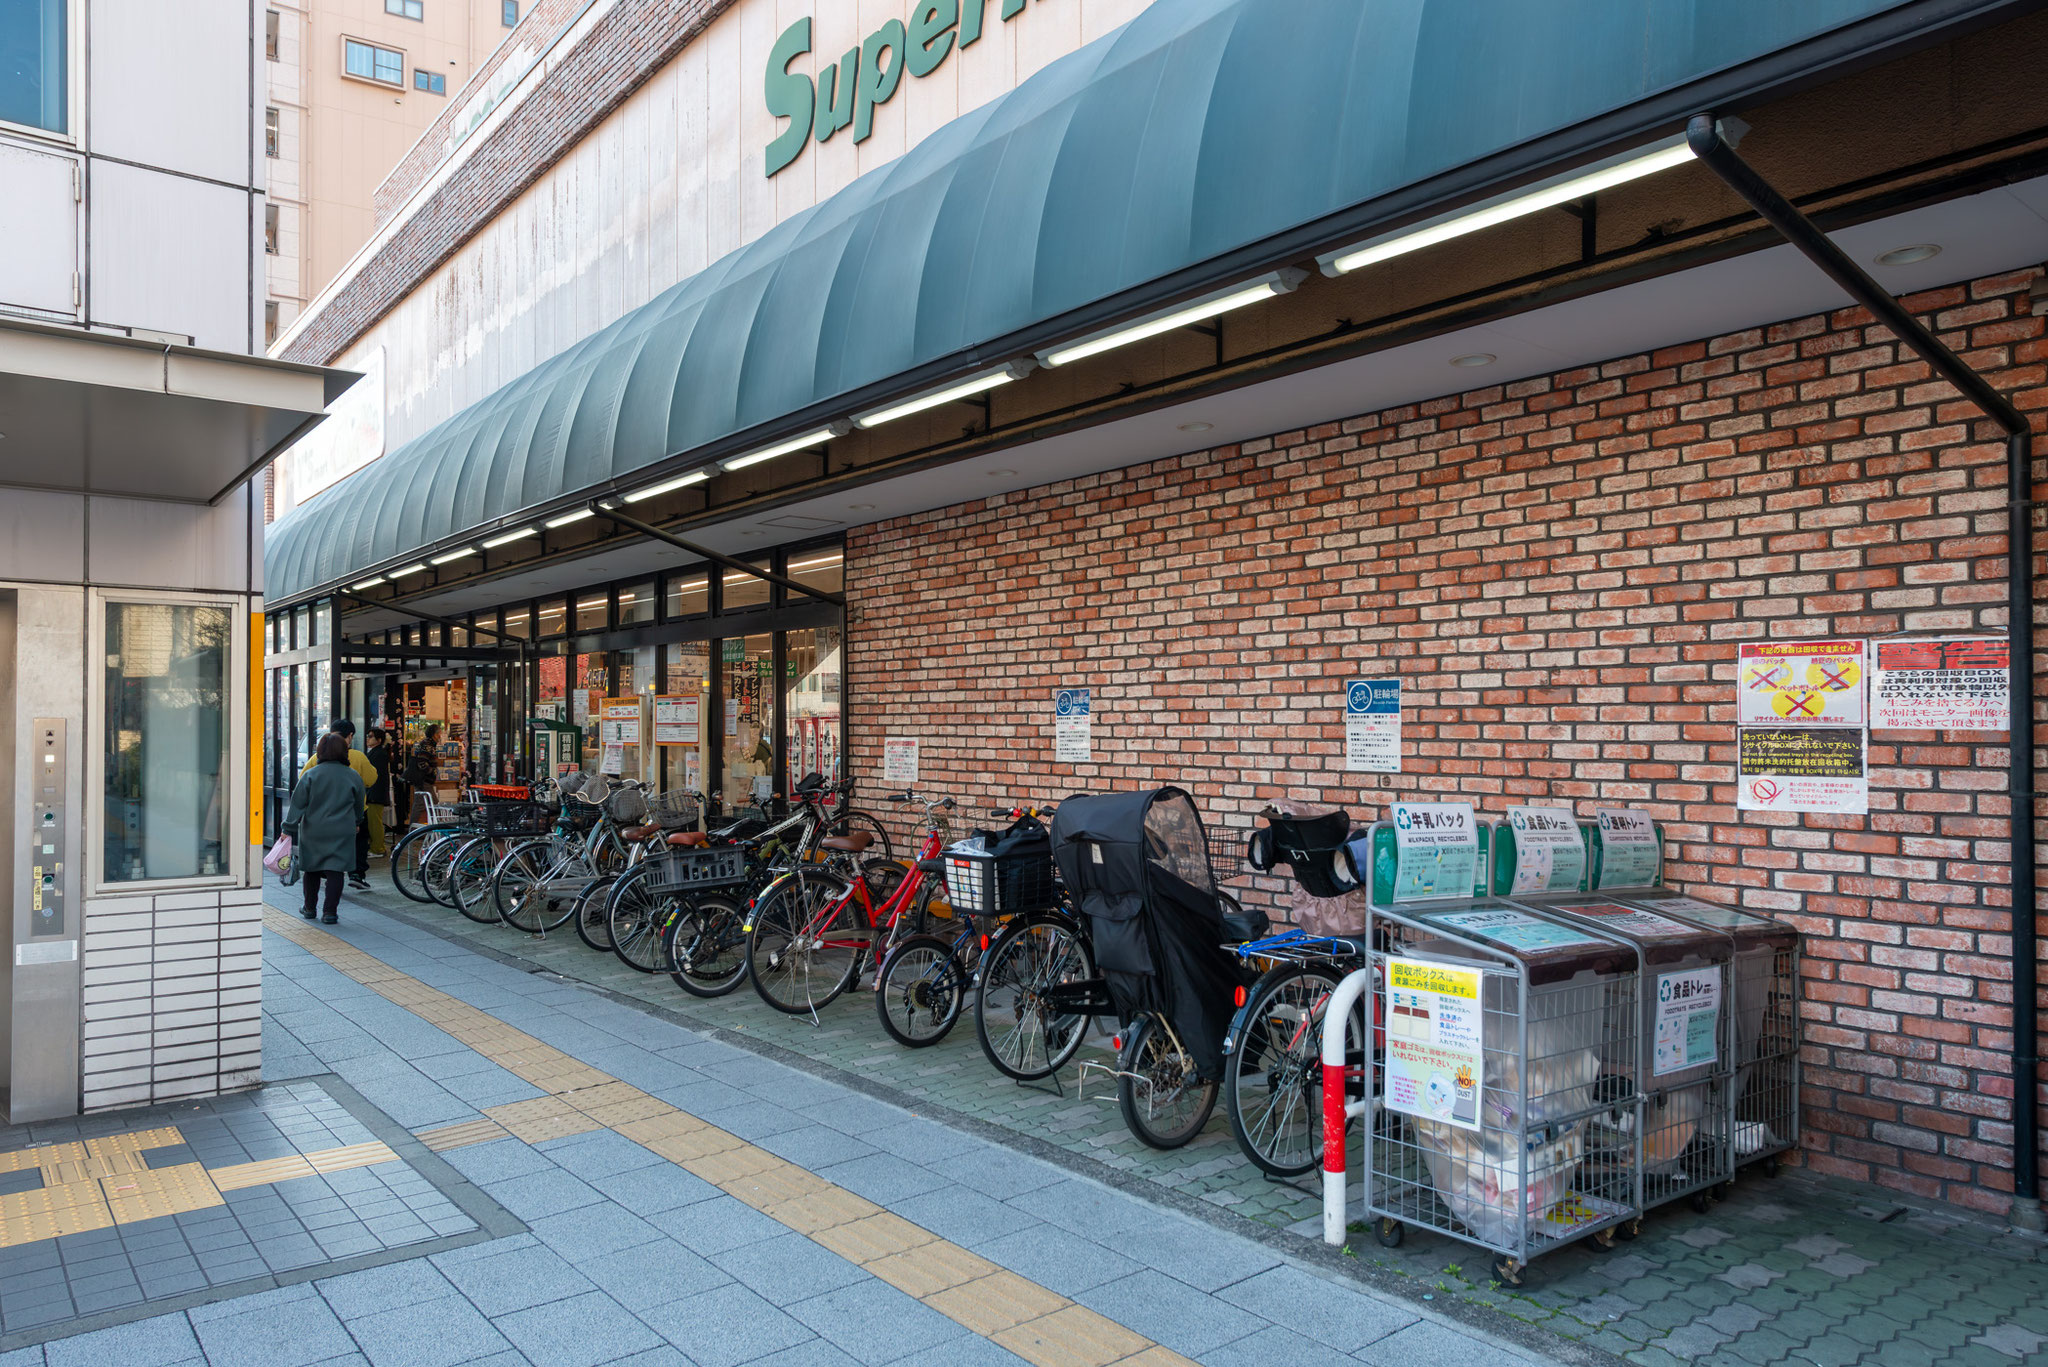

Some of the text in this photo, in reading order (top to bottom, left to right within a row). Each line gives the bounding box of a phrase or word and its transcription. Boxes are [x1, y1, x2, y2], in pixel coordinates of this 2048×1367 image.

[1878, 640, 2010, 670] 警告
[1887, 698, 2003, 706] 生ごみを捨てる方へ
[1880, 708, 2010, 718] 次回はモニター画像を
[1888, 718, 2000, 727] 掲示させて頂きます
[1412, 812, 1464, 829] 牛乳パック
[1527, 815, 1567, 830] 食品トレー
[1394, 965, 1453, 982] 回収ボックスは
[1395, 977, 1470, 996] 資源ごみを回収します。
[1673, 980, 1711, 1000] 食品トレー
[1393, 1050, 1453, 1070] いれないで下さい。
[1457, 1089, 1470, 1098] DUST
